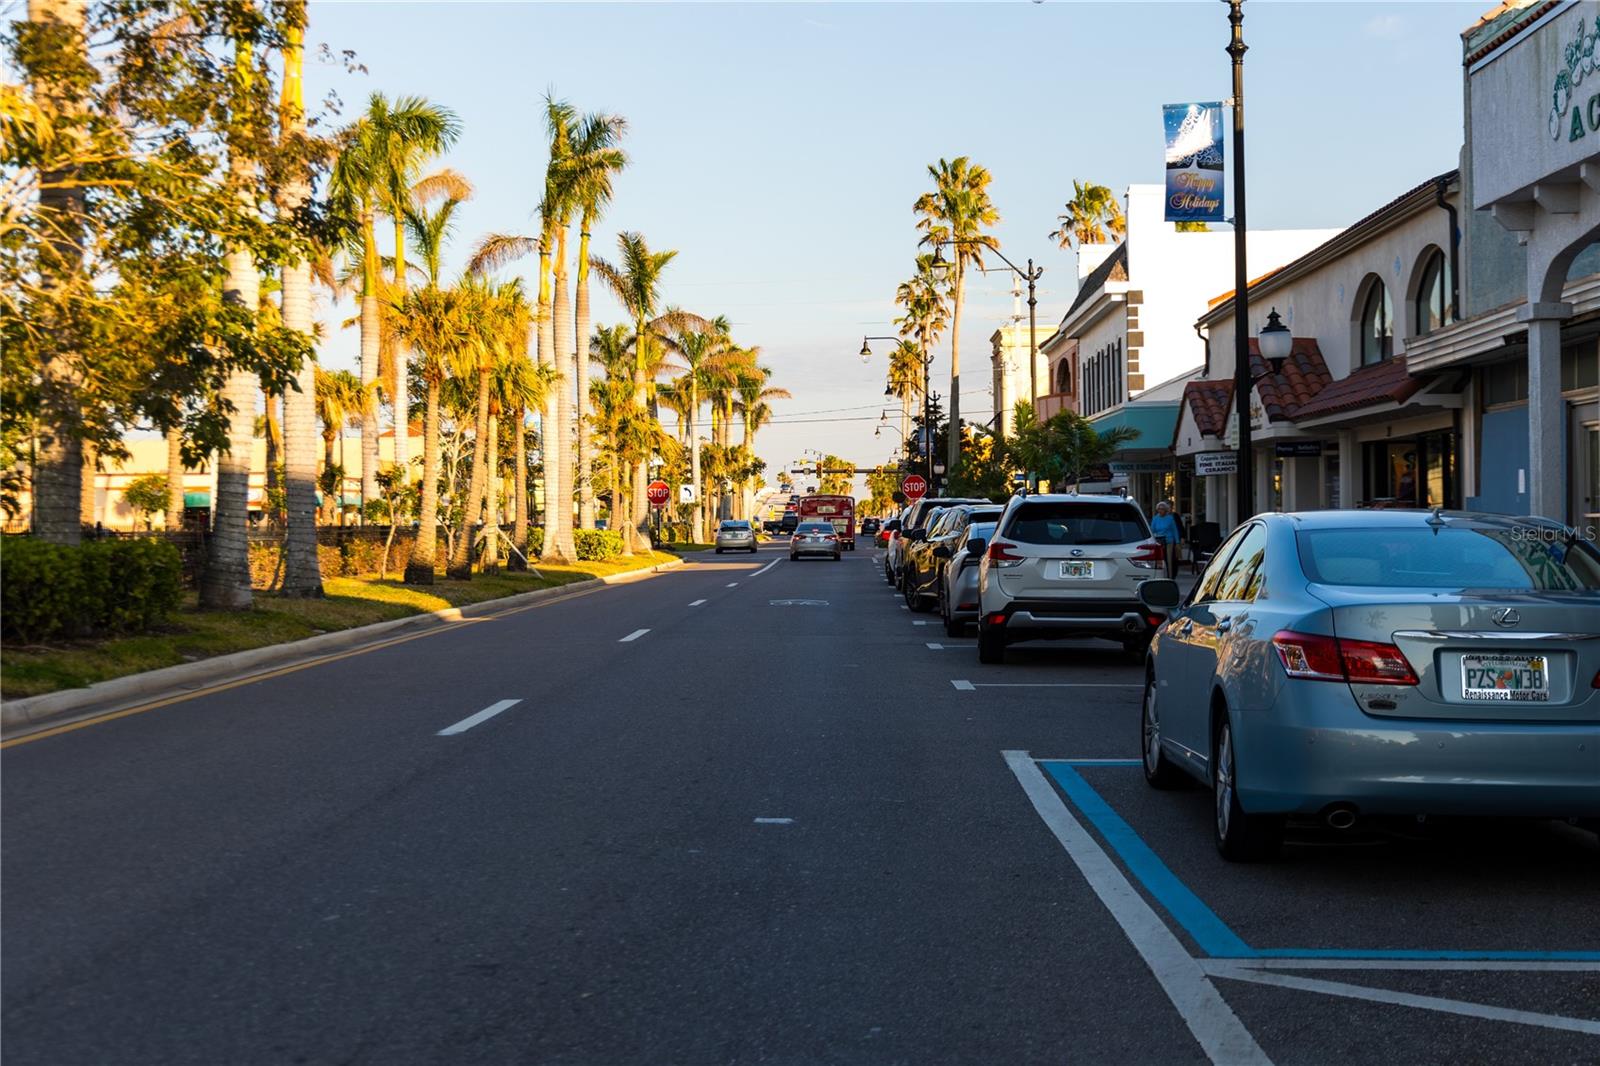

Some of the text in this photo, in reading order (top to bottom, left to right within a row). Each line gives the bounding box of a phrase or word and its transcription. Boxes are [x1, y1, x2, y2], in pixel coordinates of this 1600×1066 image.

[1175, 173, 1215, 192] Happy
[1170, 193, 1219, 213] Holidays
[1215, 459, 1237, 467] ITALIA
[647, 488, 669, 498] STOP
[904, 482, 925, 492] STOP
[1467, 668, 1496, 689] PZS
[1464, 688, 1549, 701] Renaissance Motor Cars
